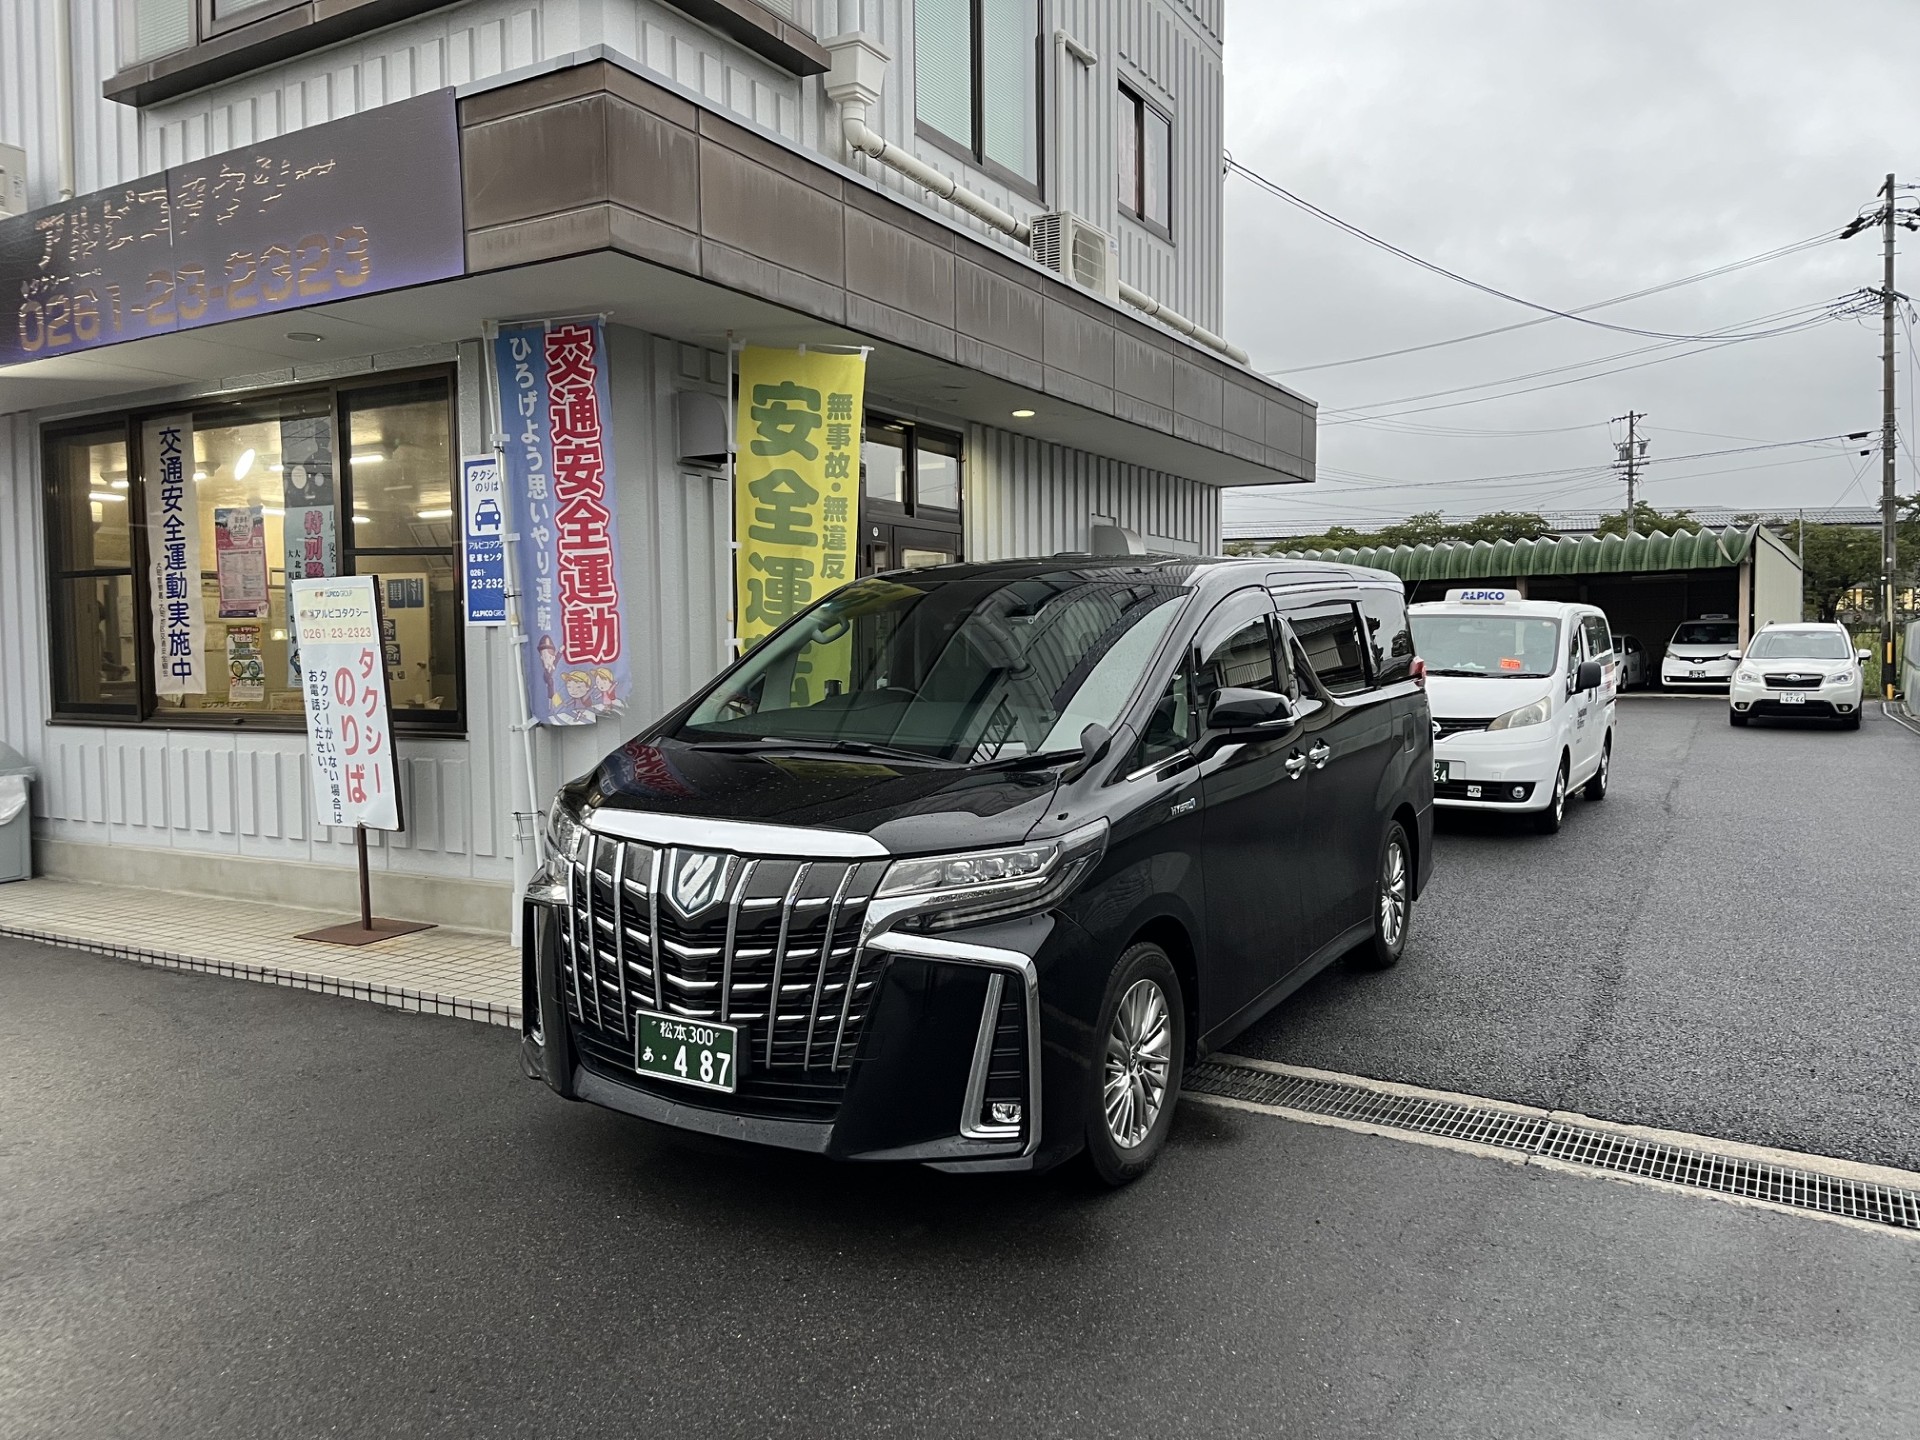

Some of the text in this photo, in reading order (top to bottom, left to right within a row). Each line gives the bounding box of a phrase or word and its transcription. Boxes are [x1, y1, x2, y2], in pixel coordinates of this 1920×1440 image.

[18, 226, 373, 352] 0261-23-2323
[471, 469, 498, 482] タクシ
[509, 336, 552, 631] ひろげよう思いやり運転
[544, 325, 620, 664] 交通安全運動
[819, 392, 853, 580] 無事故・無違反
[158, 427, 193, 685] 交通安全運動実施中
[469, 552, 503, 563] 配車センタ
[471, 578, 505, 590] 23-232
[1461, 591, 1505, 600] ALPICO
[303, 627, 372, 639] 0261-23-2323
[308, 670, 328, 774] お電話ください。
[319, 671, 343, 824] タクシーがいない場合は
[334, 667, 367, 804] のりば
[358, 647, 382, 794] タクシー
